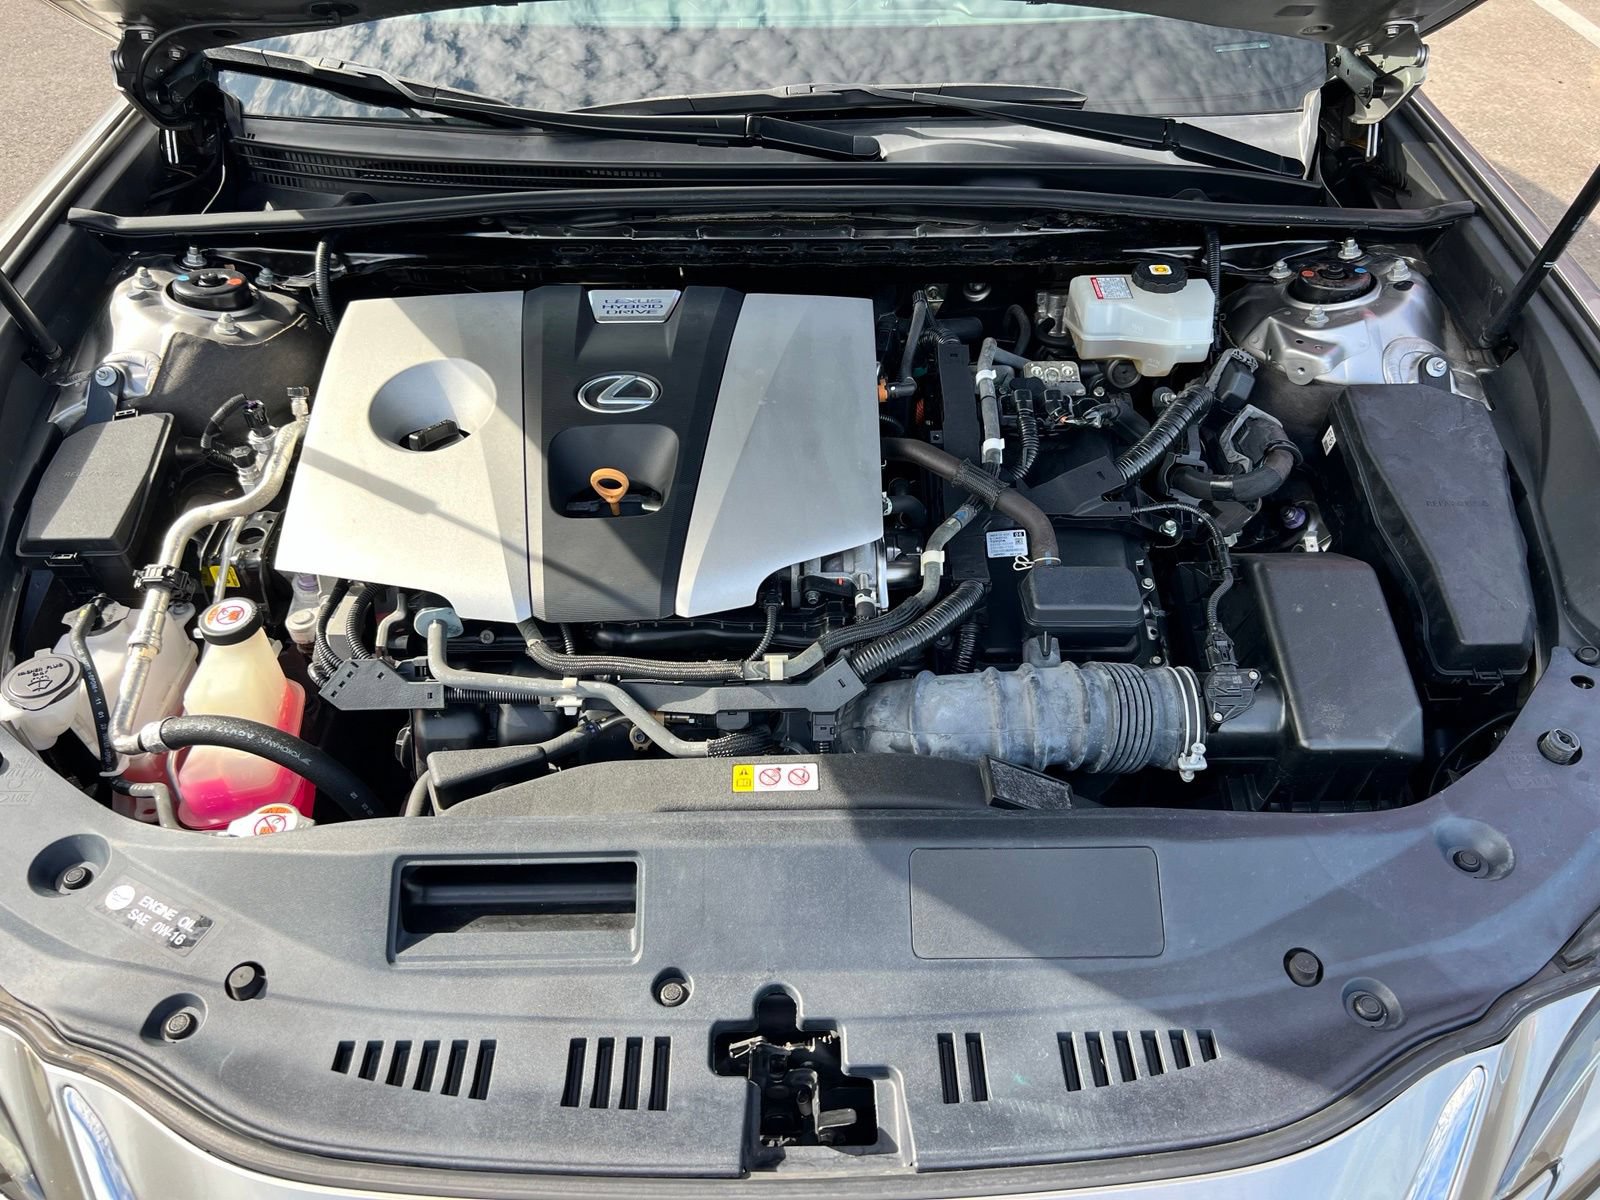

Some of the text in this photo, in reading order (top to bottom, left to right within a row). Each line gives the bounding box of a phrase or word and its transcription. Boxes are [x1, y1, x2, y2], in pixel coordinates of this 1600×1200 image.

[260, 736, 301, 759] YOKOHAMA
[127, 908, 187, 946] SAE 0W-16
[138, 896, 197, 933] ENGINE OIL
